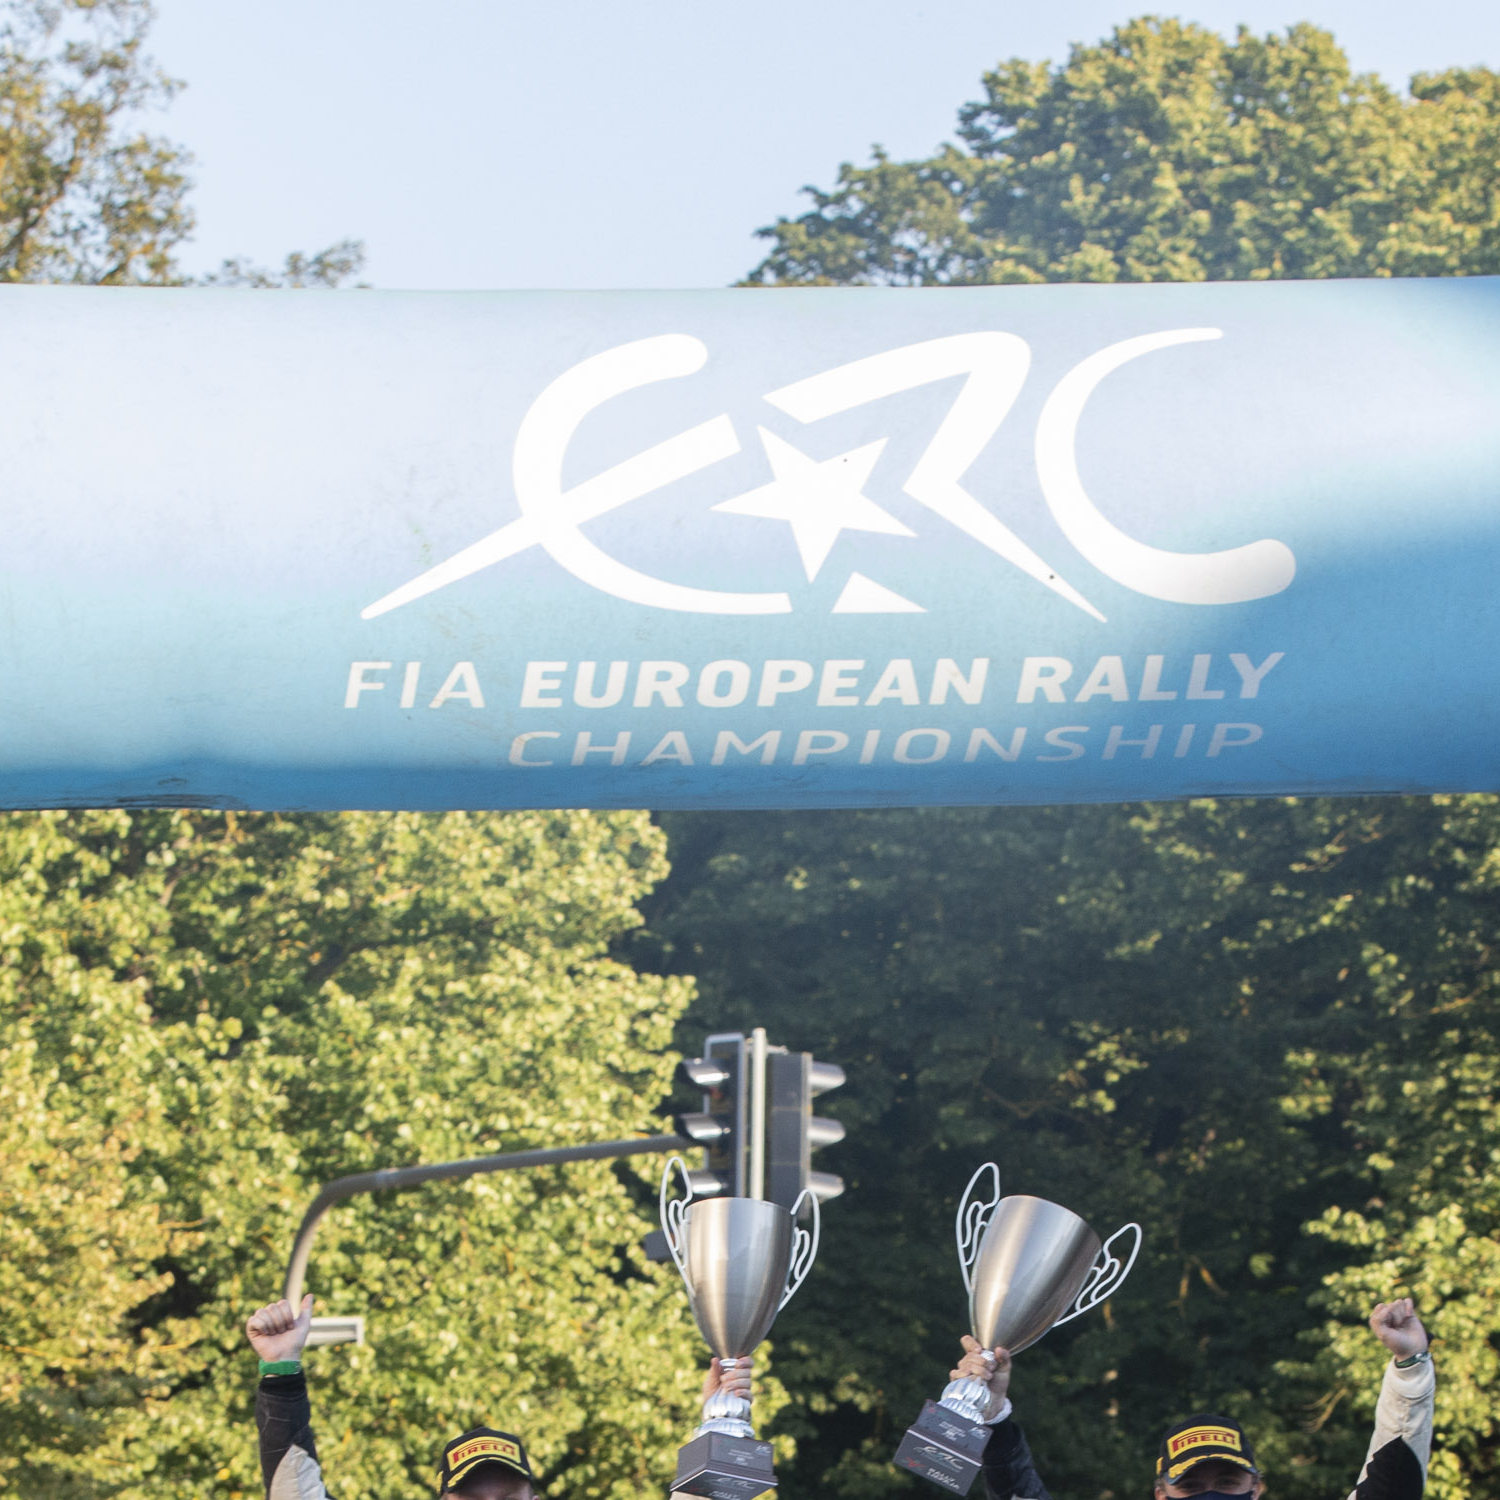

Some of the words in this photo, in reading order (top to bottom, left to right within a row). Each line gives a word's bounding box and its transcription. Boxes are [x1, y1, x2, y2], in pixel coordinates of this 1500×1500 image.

[361, 327, 1297, 623] ERC
[344, 660, 486, 710] FIA
[520, 656, 990, 710] EUROPEAN
[1015, 650, 1286, 706] RALLY
[507, 721, 1266, 768] CHAMPIONSHIP
[452, 1439, 516, 1464] PIRELLI
[1171, 1429, 1237, 1453] PIRELLI
